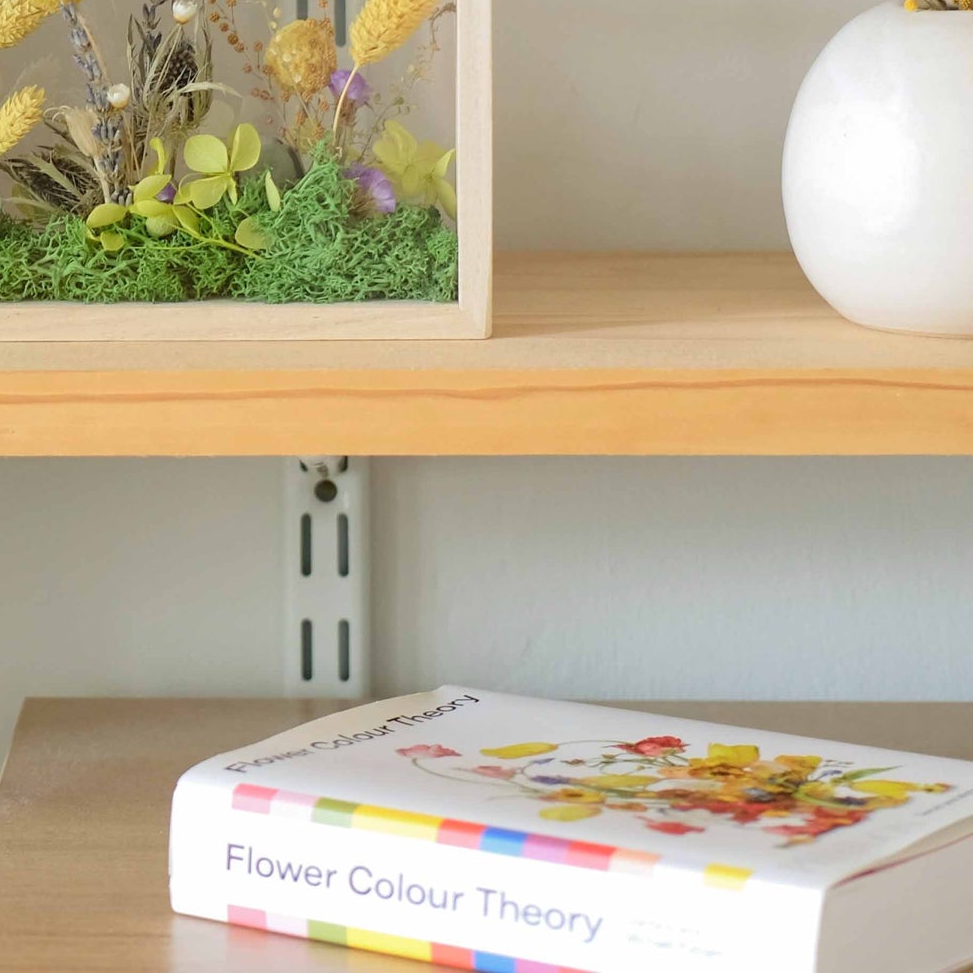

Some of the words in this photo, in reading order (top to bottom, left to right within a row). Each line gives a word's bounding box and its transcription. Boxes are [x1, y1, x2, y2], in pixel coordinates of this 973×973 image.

[224, 747, 314, 774] Flower
[310, 723, 396, 751] Colour
[386, 693, 480, 727] Theory
[226, 842, 337, 889] Flower
[348, 865, 464, 912] Colour
[476, 887, 604, 944] Theory
